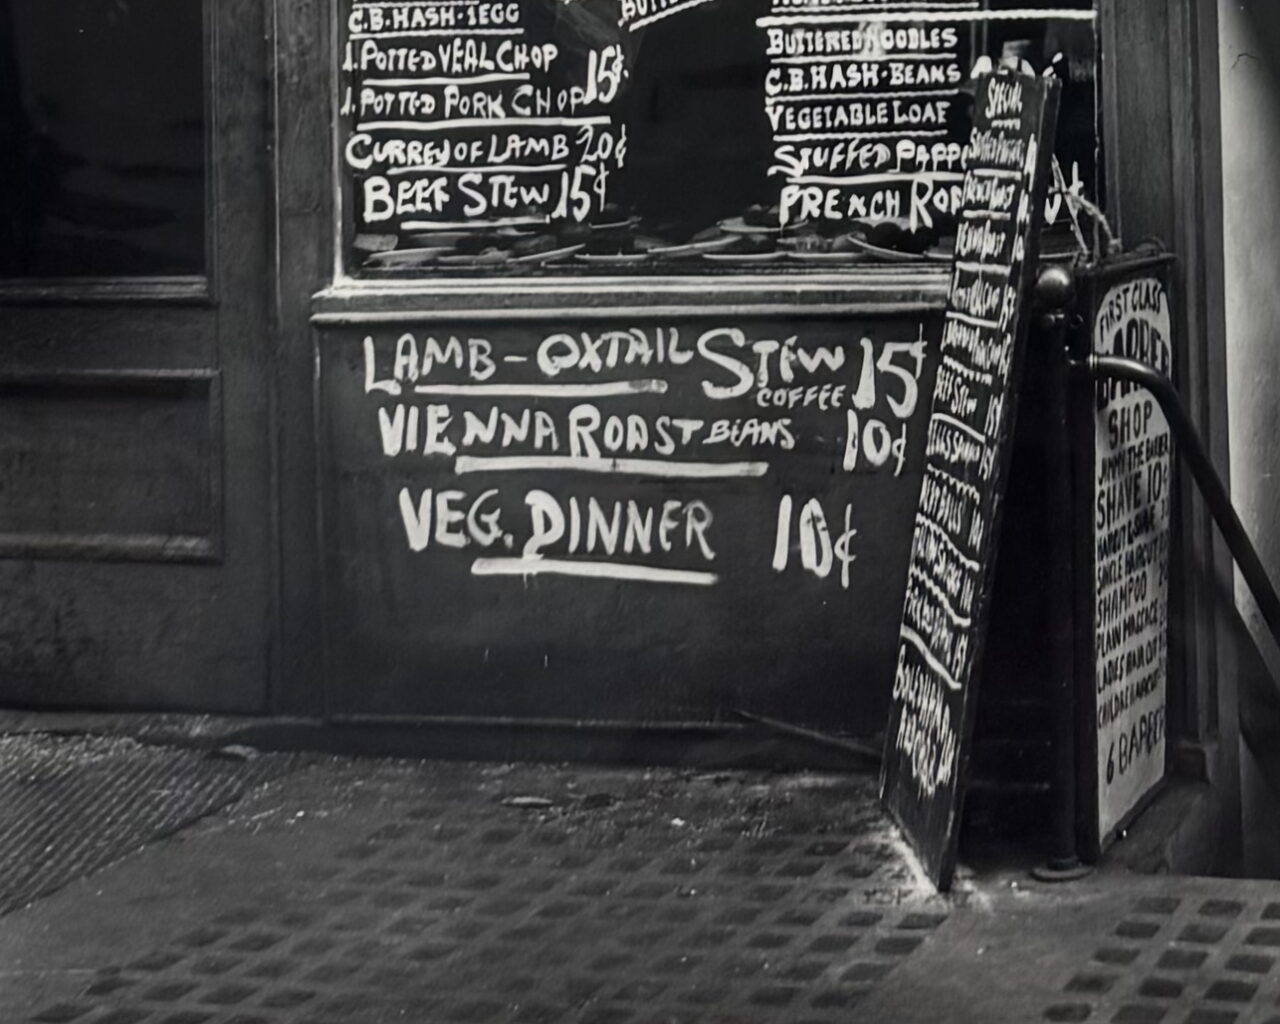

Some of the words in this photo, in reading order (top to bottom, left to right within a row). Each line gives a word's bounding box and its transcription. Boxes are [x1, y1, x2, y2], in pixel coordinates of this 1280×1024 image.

[890, 63, 961, 85] BEANS
[765, 101, 888, 131] VEGETABLE
[893, 101, 950, 124] LOAF
[363, 176, 450, 222] BEEF
[457, 172, 550, 216] STEW
[1100, 285, 1130, 344] FIRST
[363, 334, 496, 394] LAMB
[536, 328, 693, 375] OXTAIL
[697, 328, 845, 399] STEW
[757, 386, 846, 409] COFFEE
[379, 404, 559, 456] VIENNA
[568, 404, 702, 457] ROAST
[1108, 400, 1152, 449] SHOP
[399, 487, 514, 551] VEG.
[523, 489, 716, 561] DINNER
[1097, 470, 1142, 530] SHAVE
[1097, 570, 1147, 628] SHAMPOO
